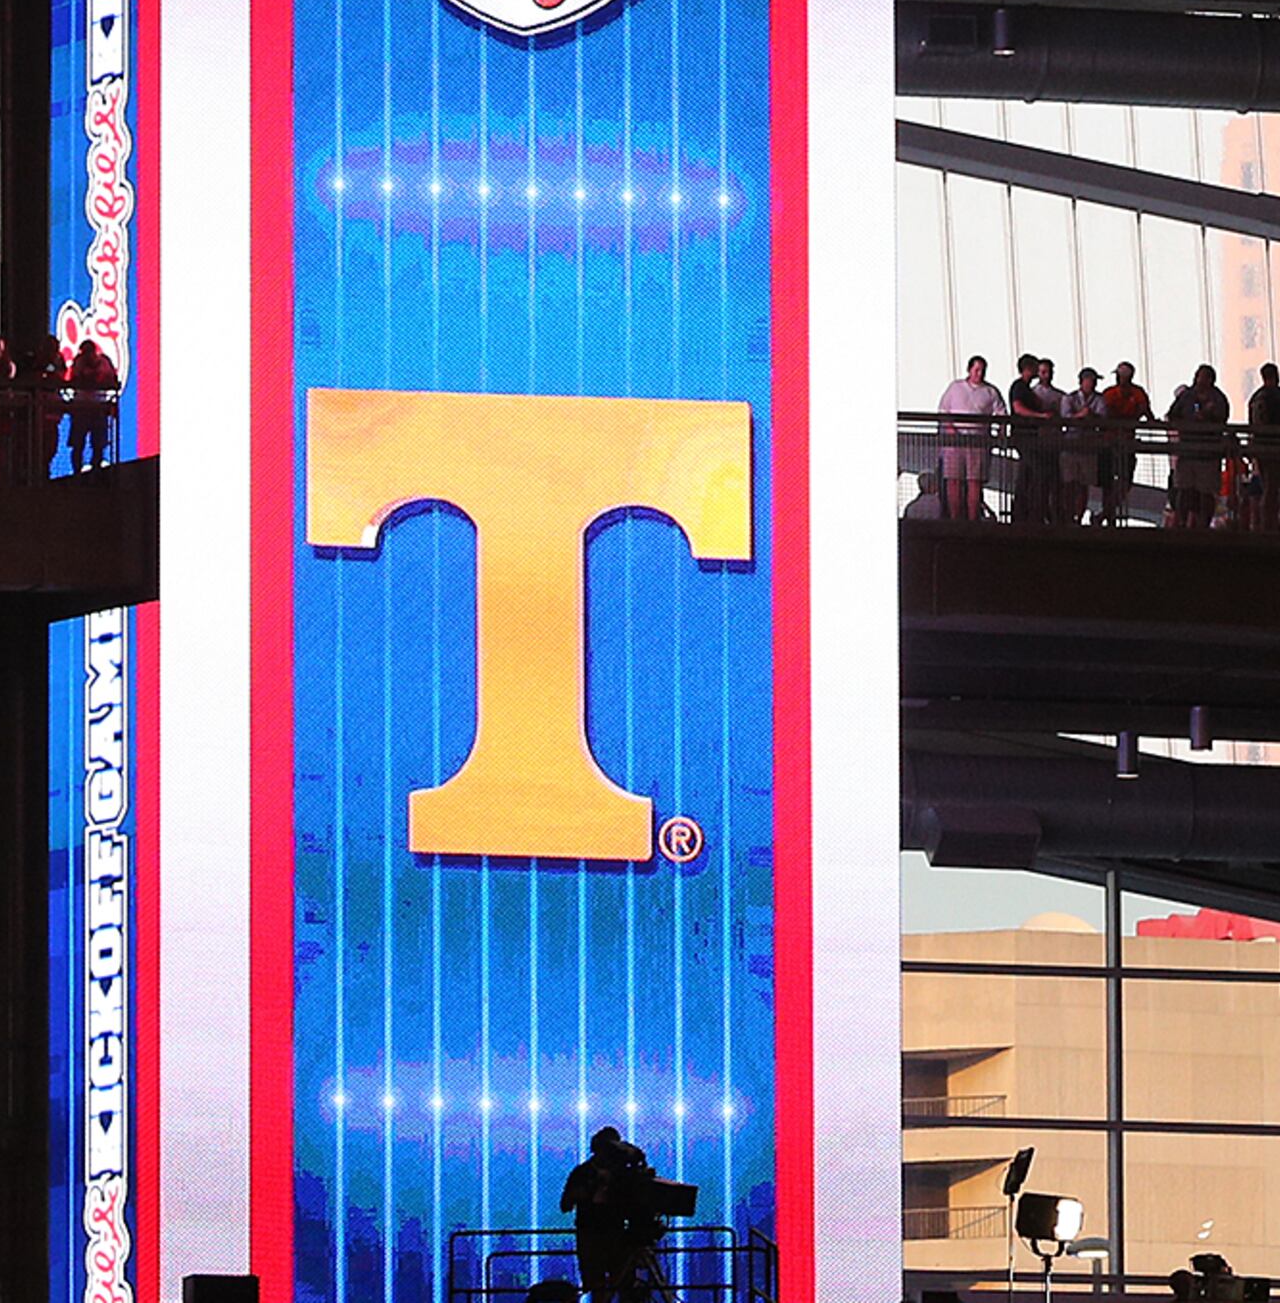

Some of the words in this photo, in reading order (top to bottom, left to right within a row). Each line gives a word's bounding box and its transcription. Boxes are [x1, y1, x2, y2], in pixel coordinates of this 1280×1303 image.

[86, 90, 126, 388] hick-fil-A
[306, 387, 752, 861] T
[89, 828, 124, 1179] KICKOFF
